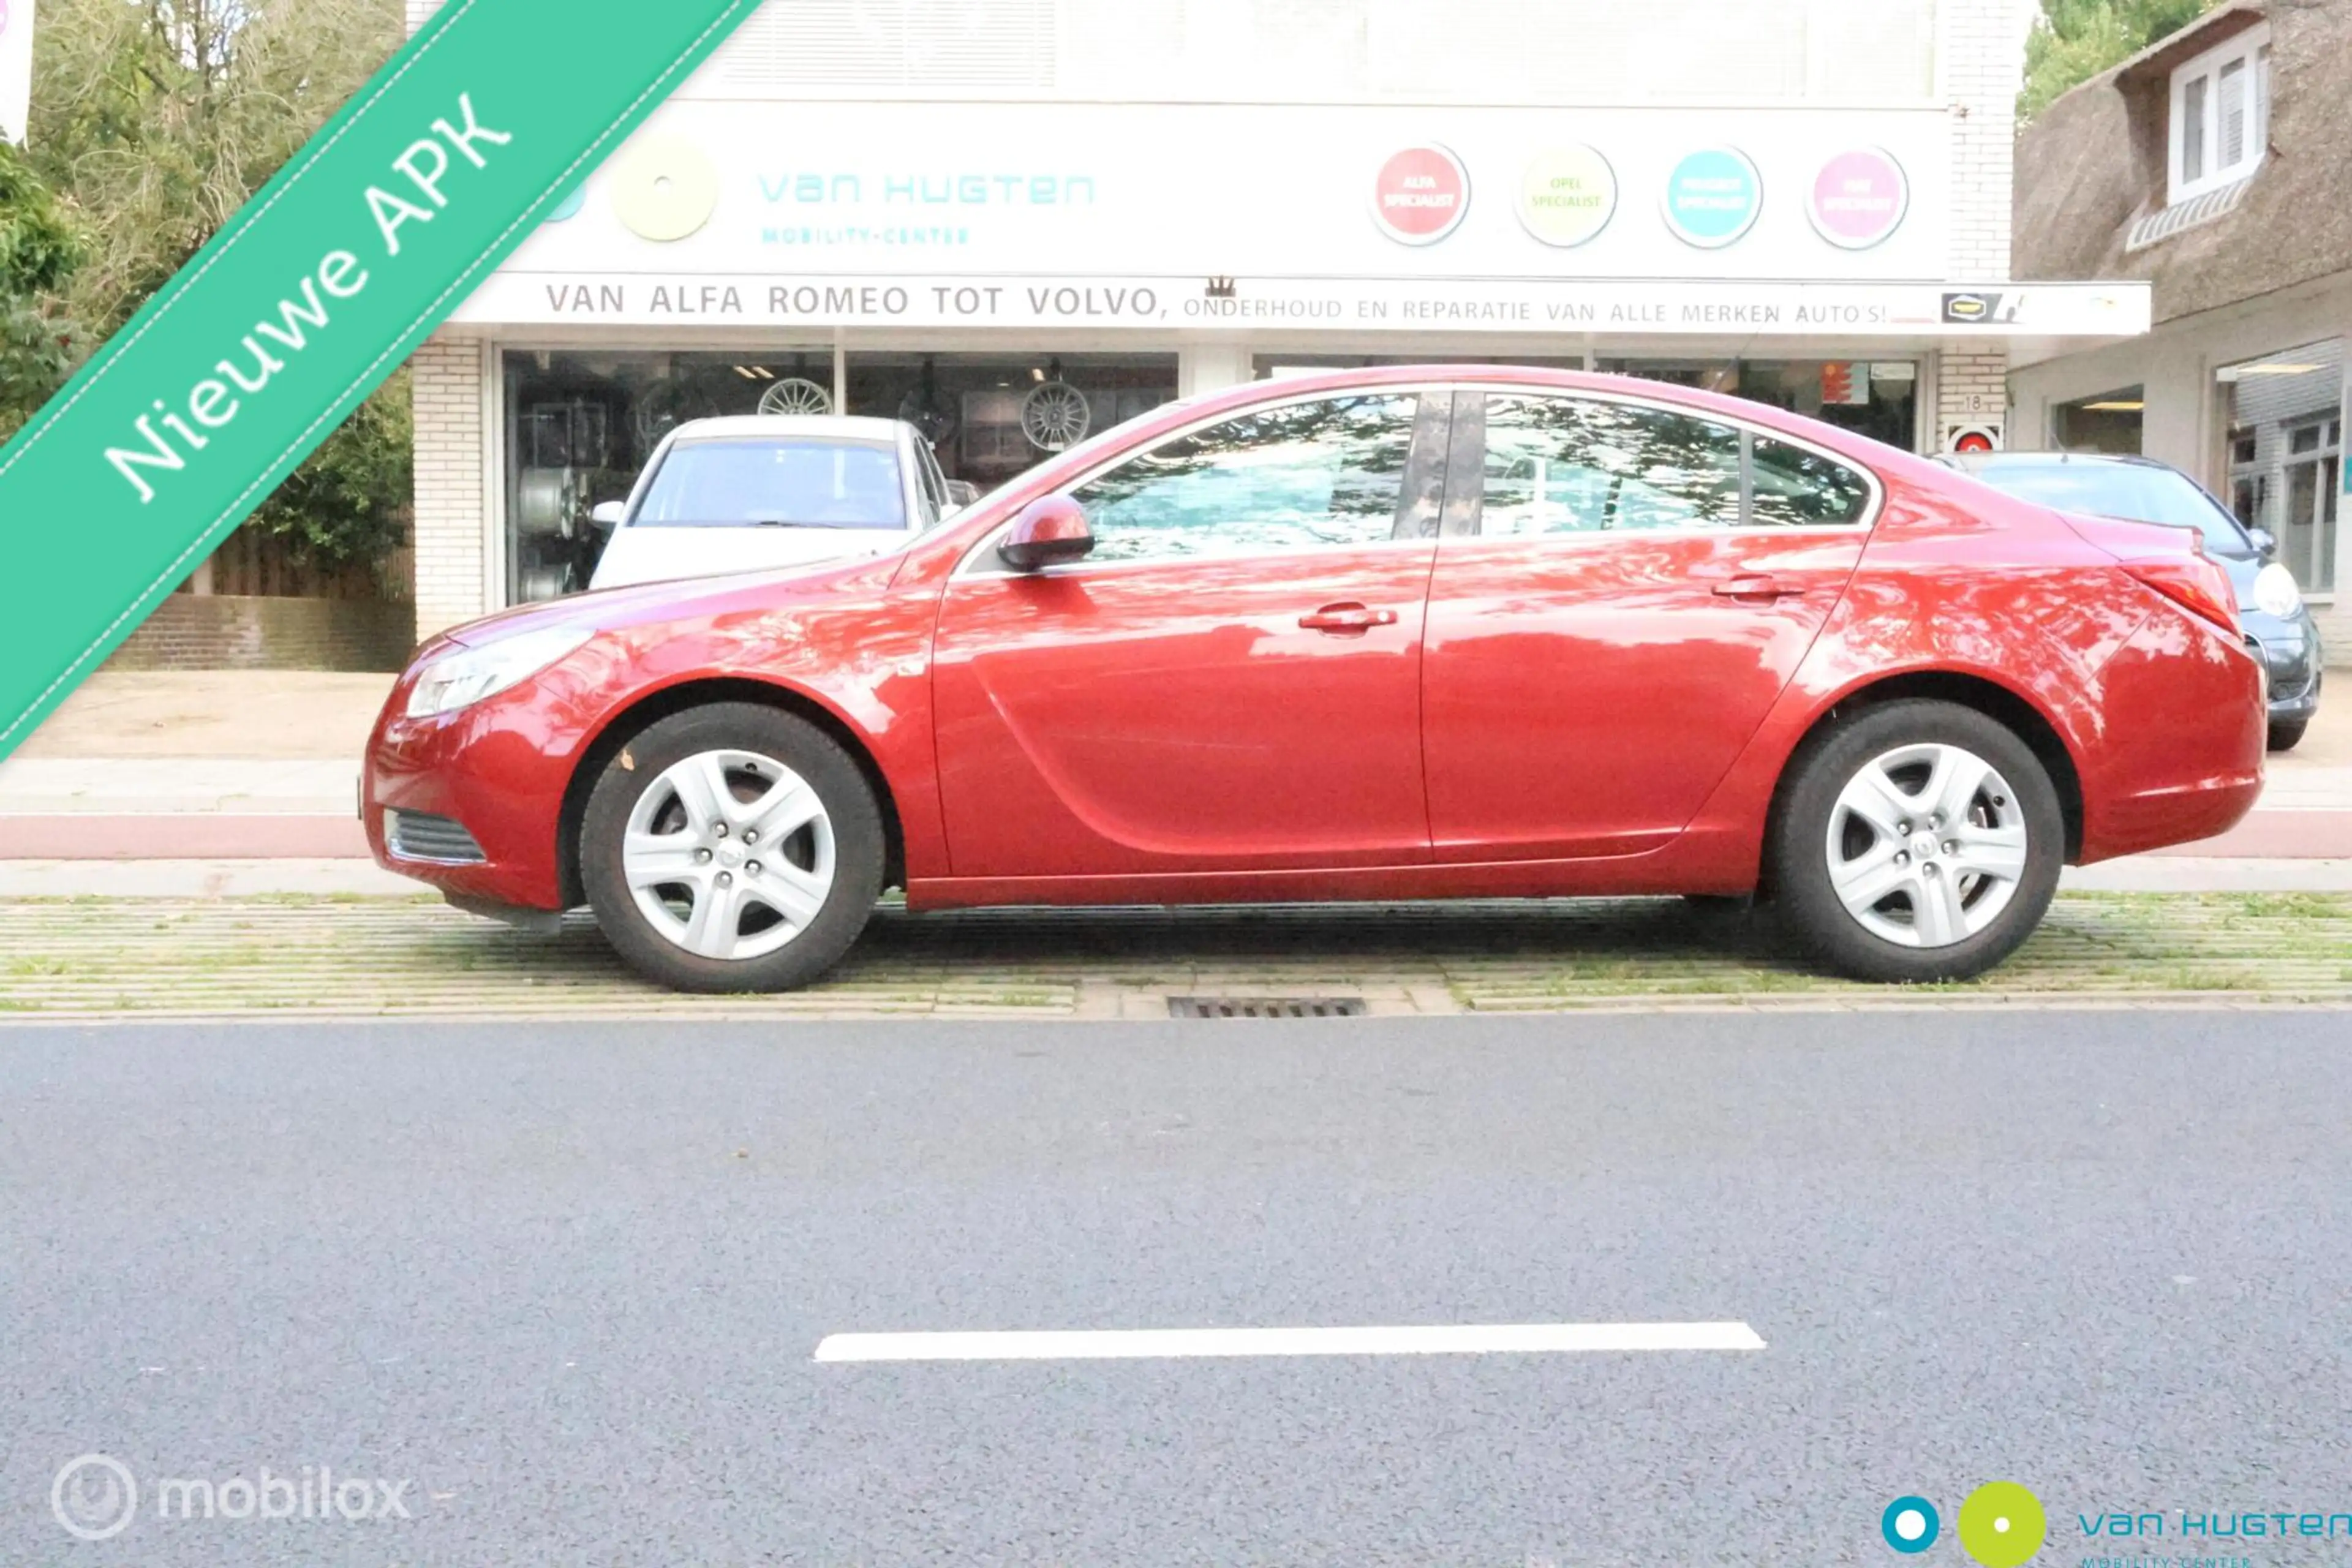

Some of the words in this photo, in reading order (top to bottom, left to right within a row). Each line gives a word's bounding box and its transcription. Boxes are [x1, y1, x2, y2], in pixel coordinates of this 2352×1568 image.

[1550, 177, 1582, 190] OPEL
[1532, 195, 1601, 207] SPECIALIST
[546, 284, 623, 313] VAN
[649, 285, 742, 314] ALFA
[769, 286, 908, 315] ROMEO
[931, 287, 1003, 315] TOT
[1027, 287, 1167, 319] VOLVO,
[1183, 298, 1342, 318] ONDERHOUD
[1357, 301, 1387, 318] EN
[1403, 301, 1530, 320] REPARATIE
[1547, 304, 1594, 320] VAN
[1610, 304, 1665, 322] ALLE
[1682, 305, 1780, 323] MERKEN
[1795, 305, 1887, 323] AUTO'S!
[1966, 395, 1981, 410] 18
